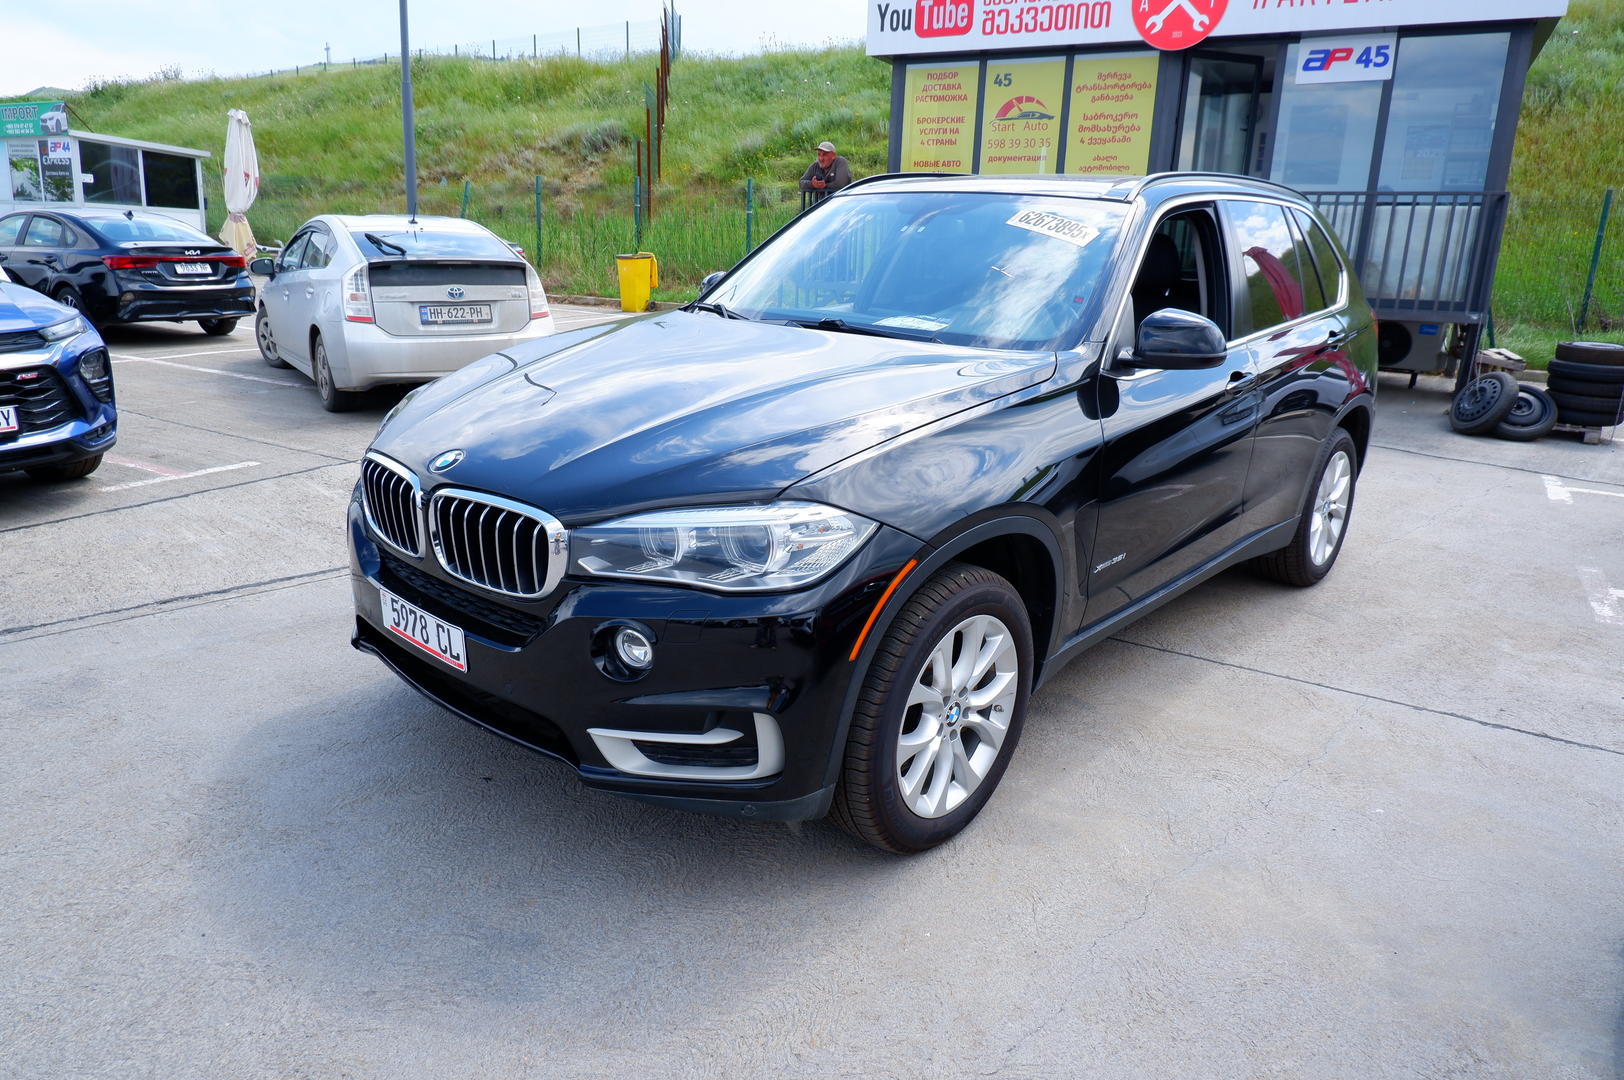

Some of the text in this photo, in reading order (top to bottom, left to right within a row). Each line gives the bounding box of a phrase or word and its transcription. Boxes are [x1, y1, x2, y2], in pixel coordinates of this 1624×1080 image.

[1356, 45, 1390, 68] 45
[927, 72, 959, 81] ПОДБОР
[993, 73, 1012, 87] 45
[922, 83, 962, 93] ДОСТАВКА
[915, 94, 968, 103] РАСТОМОЖКА
[1, 105, 38, 120] IMPORT
[916, 116, 966, 125] БРОКЕРСКИЕ
[991, 120, 1049, 132] Start Auto
[919, 127, 960, 136] УСЛУГИ НА
[62, 141, 71, 152] 44
[926, 138, 957, 146] СТРАНЫ
[987, 138, 1006, 149] 598
[1008, 138, 1021, 149] 39
[1023, 137, 1037, 148] 30
[913, 160, 940, 168] НОВЫЕ
[429, 307, 483, 319] HH-622-PH
[391, 597, 461, 661] 5978 CL
